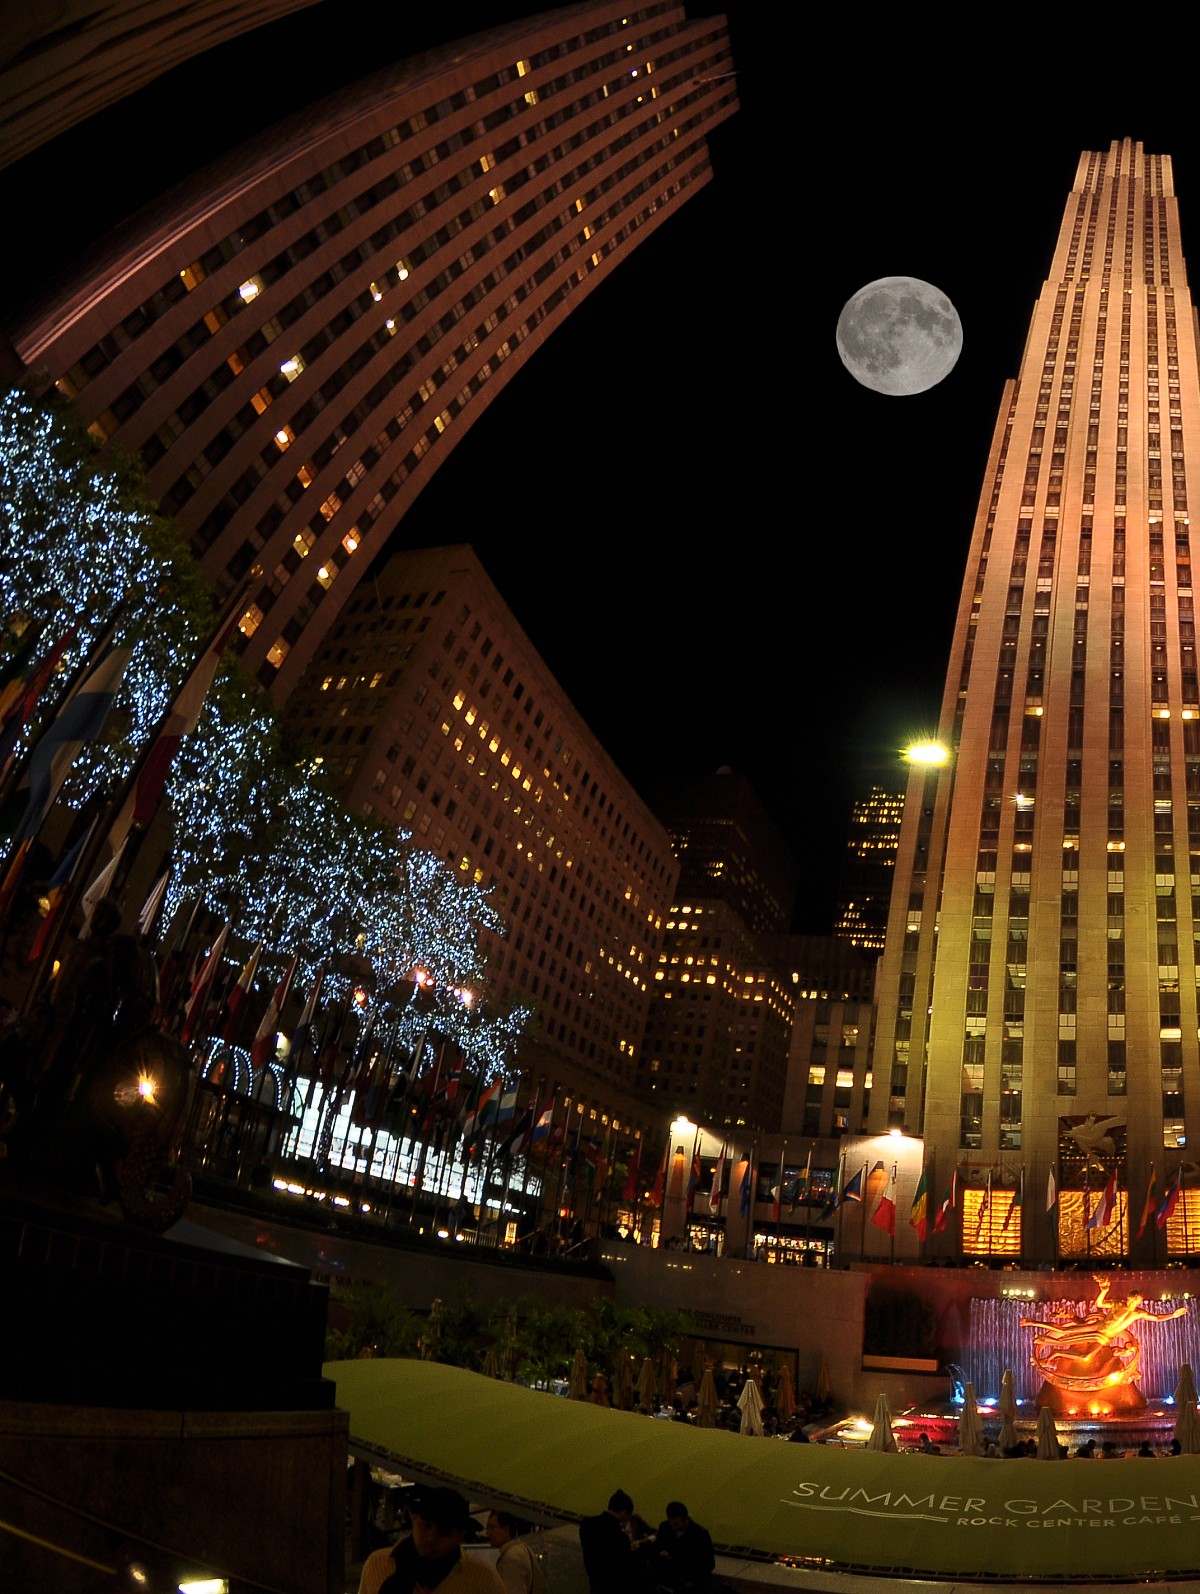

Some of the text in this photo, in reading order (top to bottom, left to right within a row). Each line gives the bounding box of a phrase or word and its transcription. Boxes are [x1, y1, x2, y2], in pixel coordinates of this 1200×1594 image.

[694, 1310, 742, 1323] CONCOURSE
[722, 1325, 755, 1335] CENTER
[792, 1482, 986, 1513] SUMMER
[1003, 1494, 1199, 1515] GARDEN
[956, 1516, 1018, 1528] ROCK
[1025, 1518, 1116, 1529] CENTER
